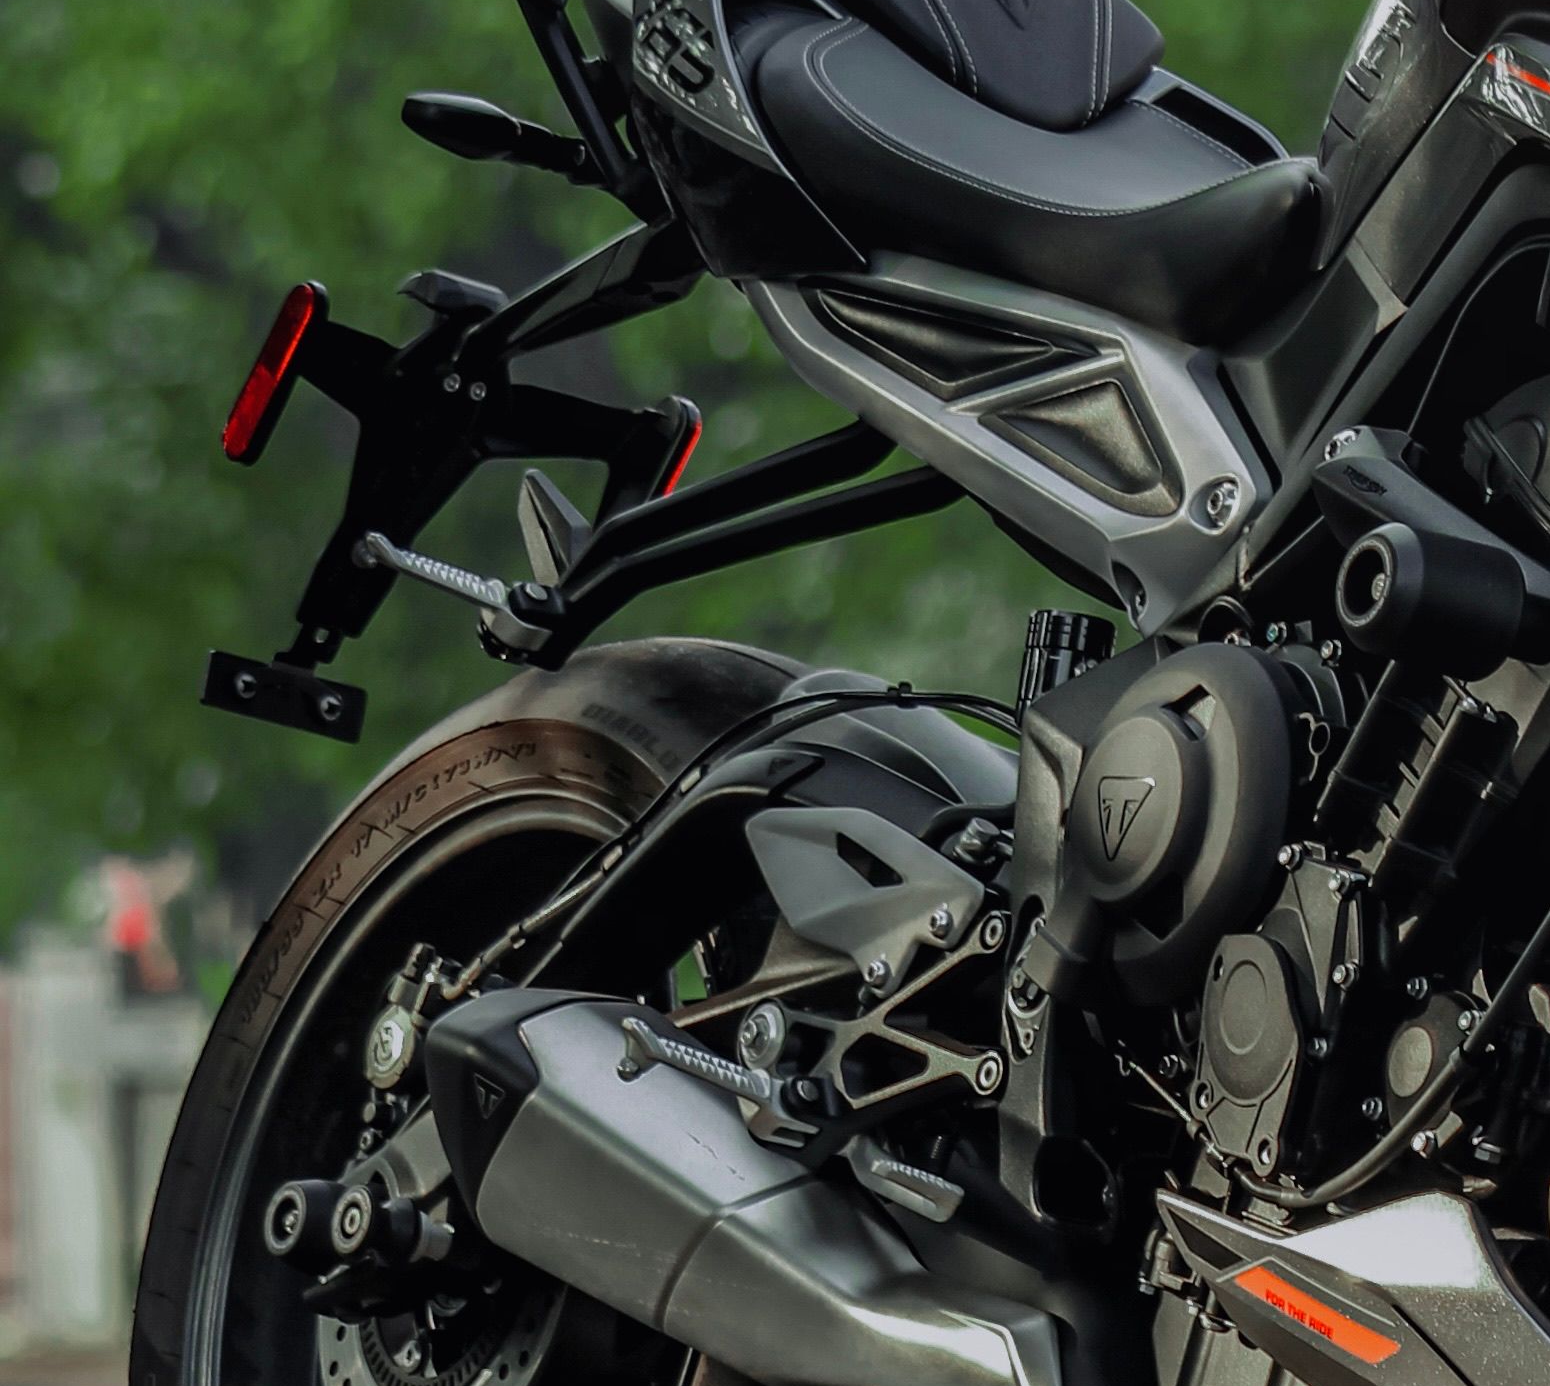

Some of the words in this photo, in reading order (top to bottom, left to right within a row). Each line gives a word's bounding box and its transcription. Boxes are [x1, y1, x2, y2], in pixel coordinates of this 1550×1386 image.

[1265, 1289, 1285, 1312] FOR
[1287, 1302, 1307, 1324] THE
[1308, 1315, 1334, 1340] RIDE
